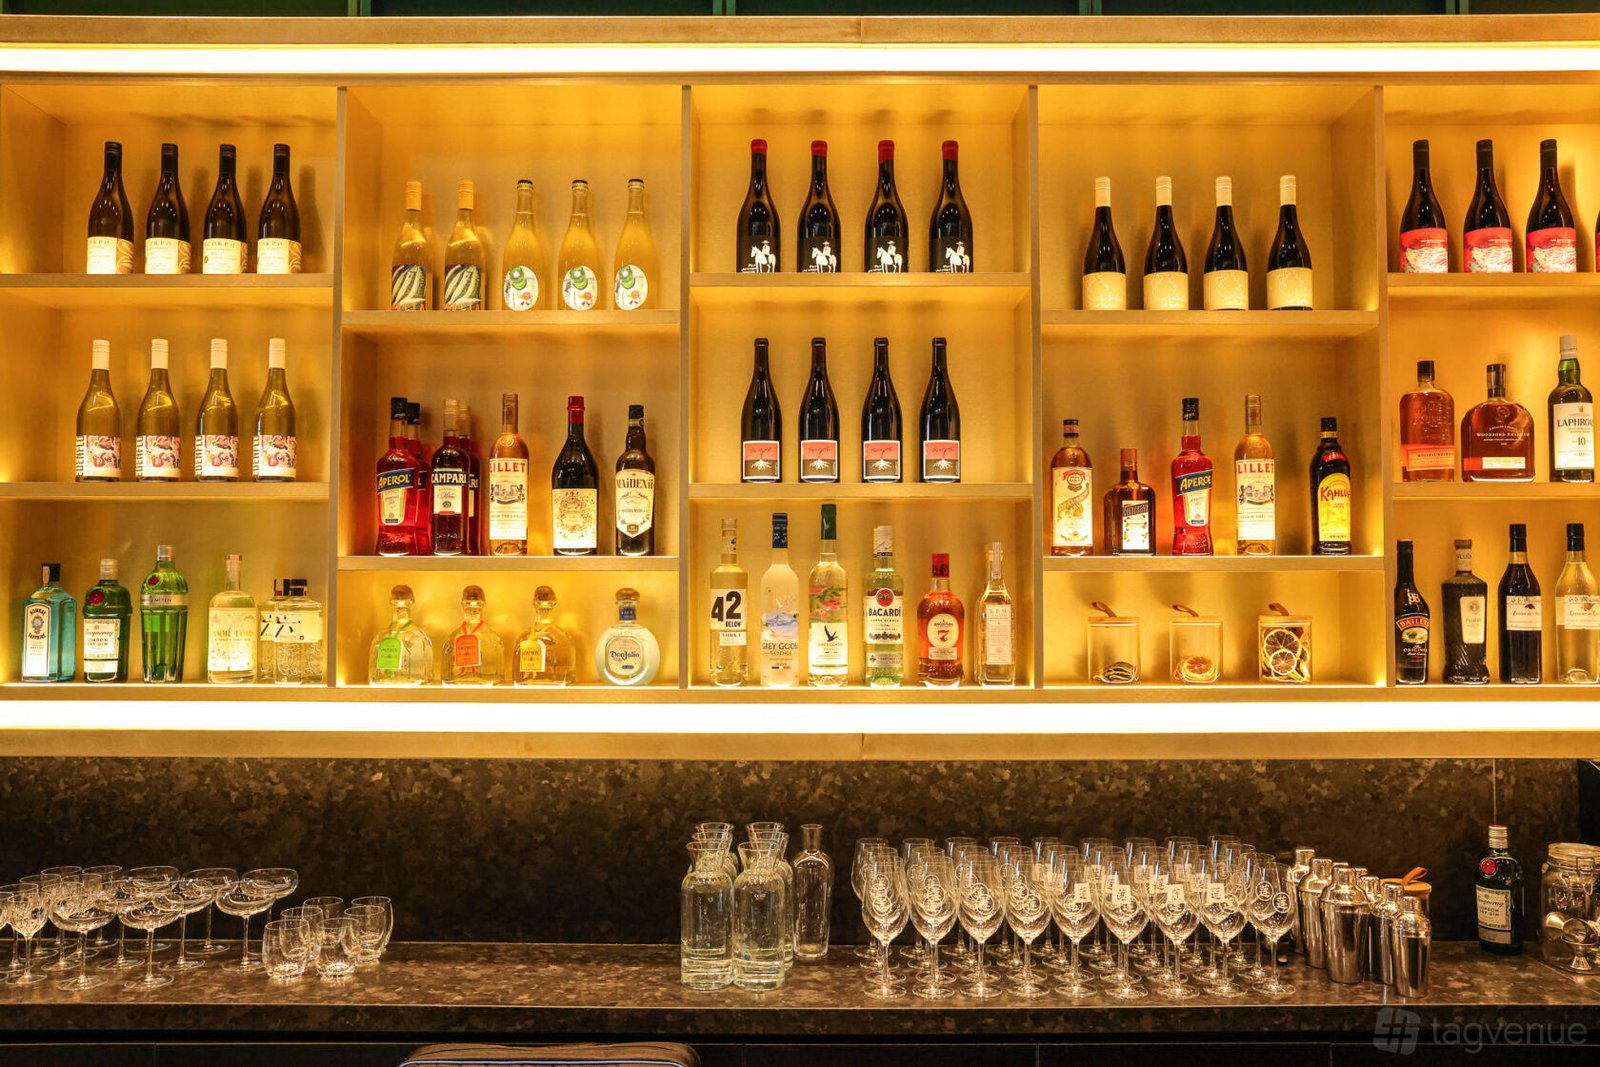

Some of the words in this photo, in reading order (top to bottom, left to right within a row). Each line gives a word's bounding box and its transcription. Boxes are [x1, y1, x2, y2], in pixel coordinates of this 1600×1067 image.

[1577, 436, 1586, 446] 10
[378, 473, 410, 489] APEROL
[431, 473, 467, 484] CAMPARI
[711, 591, 742, 623] 42
[725, 621, 741, 629] BELOW
